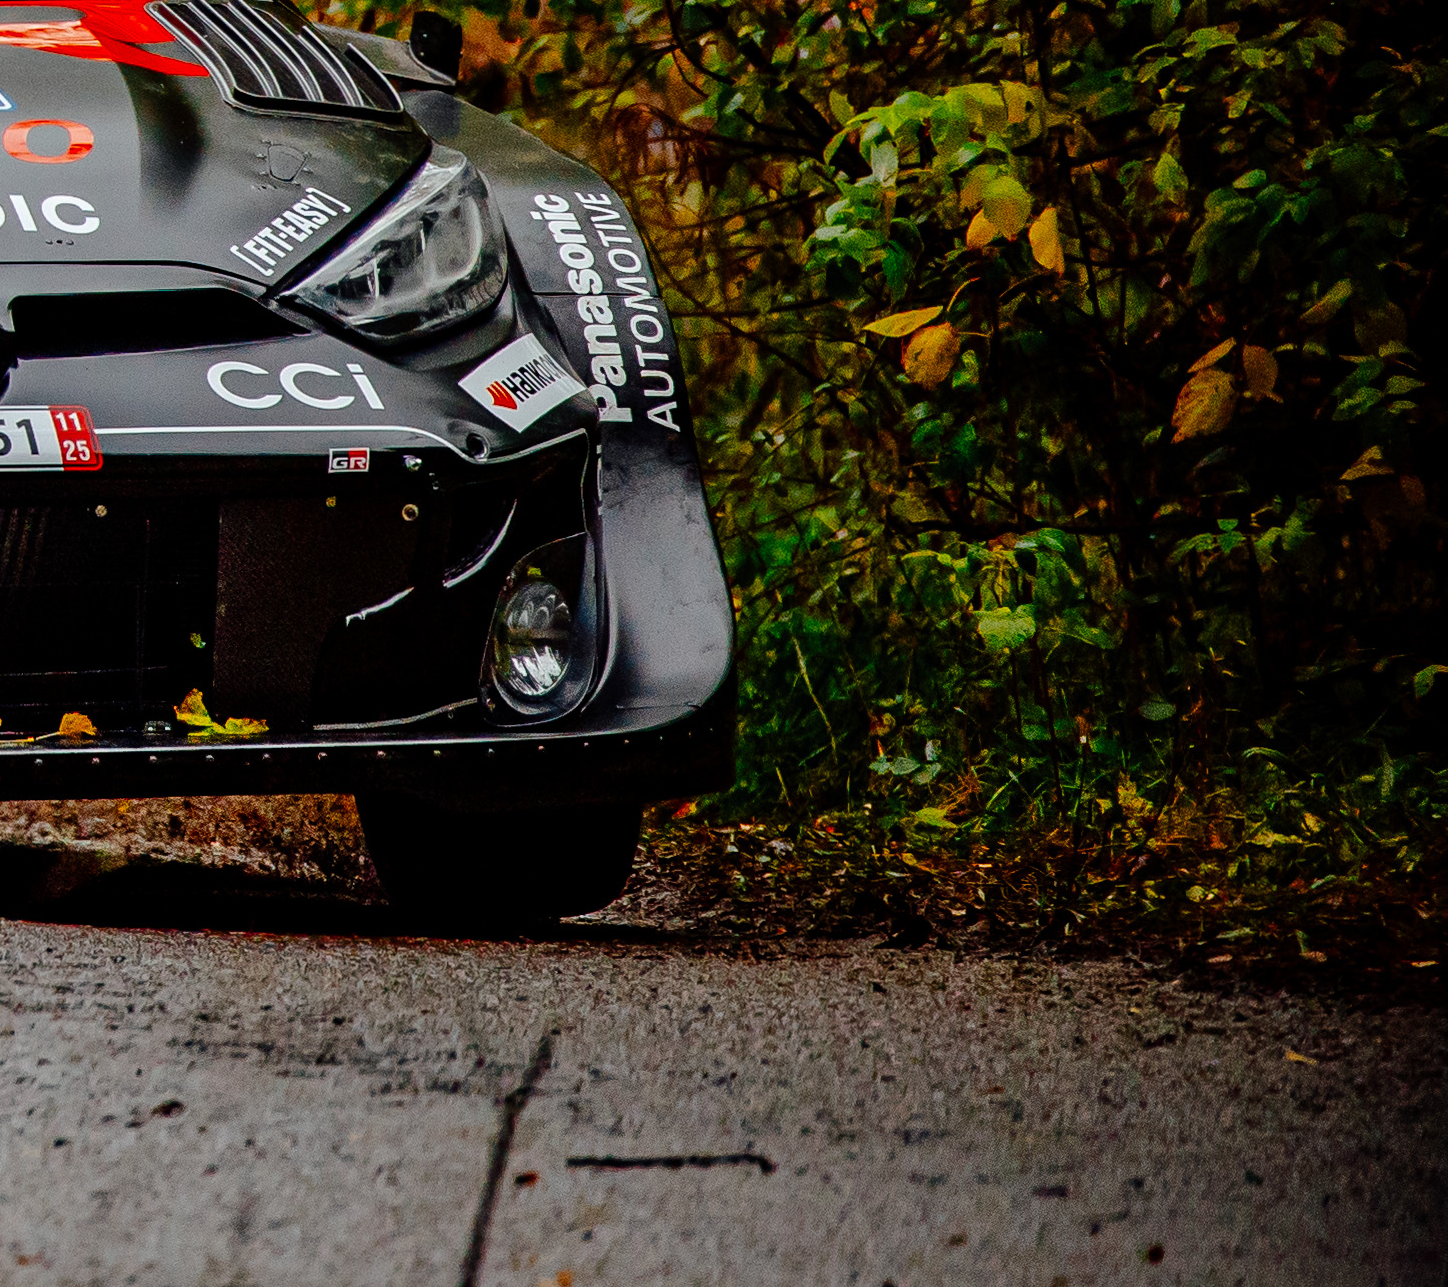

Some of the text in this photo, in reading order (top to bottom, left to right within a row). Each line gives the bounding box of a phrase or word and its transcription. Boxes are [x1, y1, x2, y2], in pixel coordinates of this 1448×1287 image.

[529, 193, 633, 423] Panasonic
[574, 191, 681, 433] AUTOMOTIVE
[56, 411, 83, 432] 11
[62, 439, 92, 462] 25
[331, 454, 368, 471] GR
